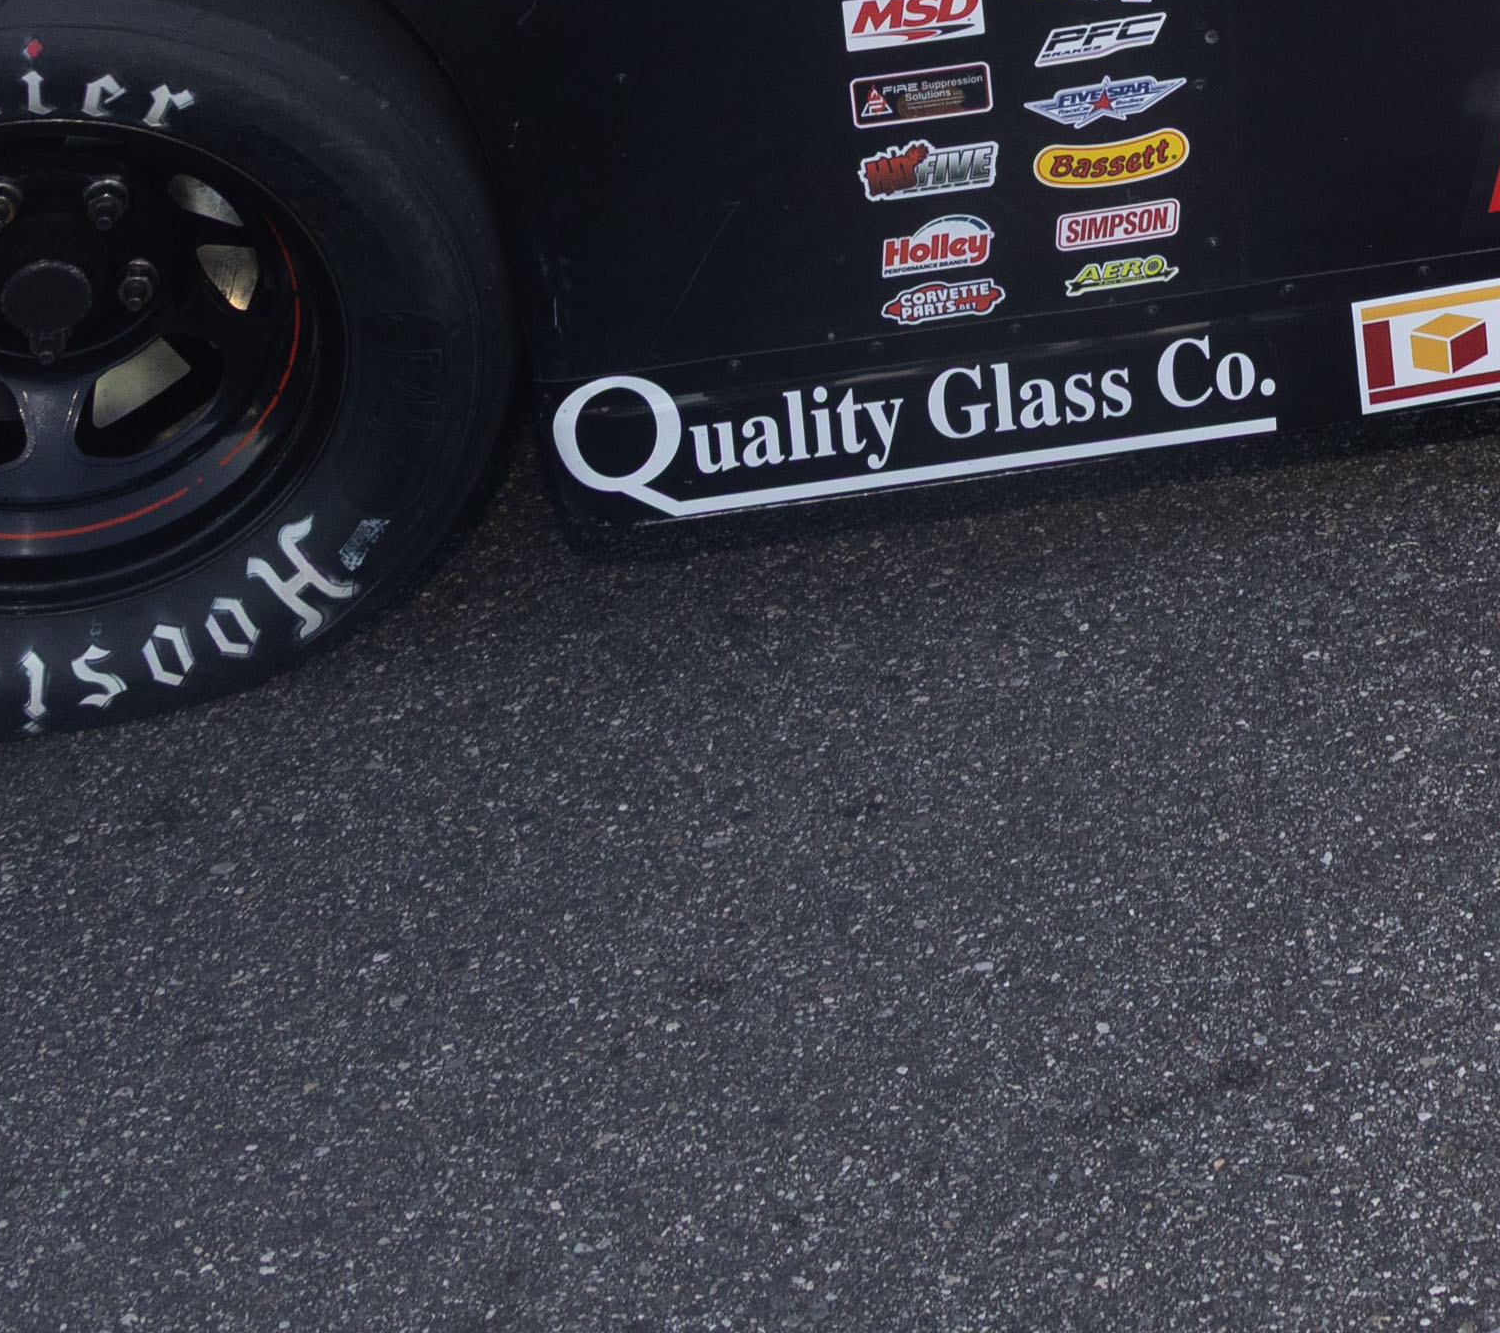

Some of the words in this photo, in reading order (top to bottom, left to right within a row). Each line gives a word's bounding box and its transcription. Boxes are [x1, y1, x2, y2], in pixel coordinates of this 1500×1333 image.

[1044, 15, 1164, 52] PFC
[1041, 45, 1102, 59] BRAKES
[905, 89, 951, 102] Solutions
[921, 75, 983, 90] Suppression
[1057, 90, 1101, 108] FIVE
[1107, 82, 1151, 97] STAR
[1049, 139, 1169, 178] Bassett
[1065, 206, 1169, 244] SIMPSON
[884, 233, 989, 267] Holley
[884, 262, 938, 276] PERFORMANCE
[939, 257, 969, 269] BRANDS
[1076, 256, 1165, 283] AERO
[900, 283, 989, 306] CORVETTE
[552, 373, 905, 516] Quality
[928, 357, 1133, 444] Glass
[1156, 336, 1278, 409] Co.
